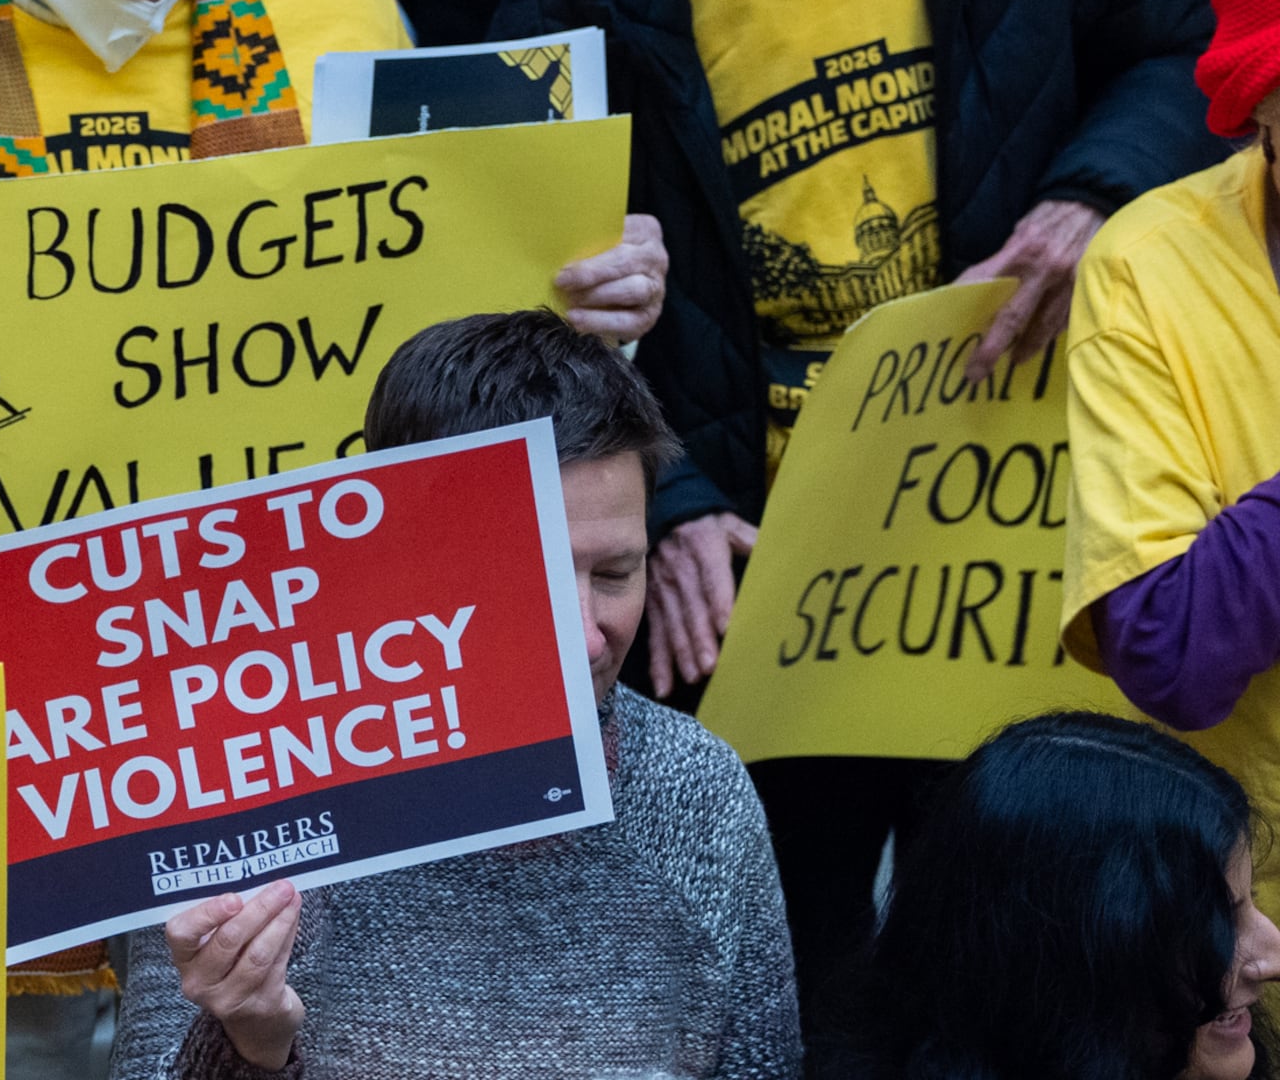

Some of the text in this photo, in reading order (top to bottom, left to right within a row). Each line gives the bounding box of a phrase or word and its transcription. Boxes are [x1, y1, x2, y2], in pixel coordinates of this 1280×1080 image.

[824, 45, 882, 79] 2026
[79, 116, 141, 137] 2026
[721, 93, 835, 166] MORAL
[759, 141, 789, 178] AT
[791, 118, 850, 161] THE
[26, 176, 429, 301] BUDGETS
[113, 304, 384, 409] SHOW
[28, 508, 245, 605] CUTS
[268, 479, 385, 552] TO
[96, 567, 320, 669] SNAP
[6, 605, 477, 766] ARE POLICY
[17, 685, 467, 841] VIOLENCE!
[147, 810, 335, 874] REPAIRERS
[156, 837, 335, 892] OF THE BREACH
